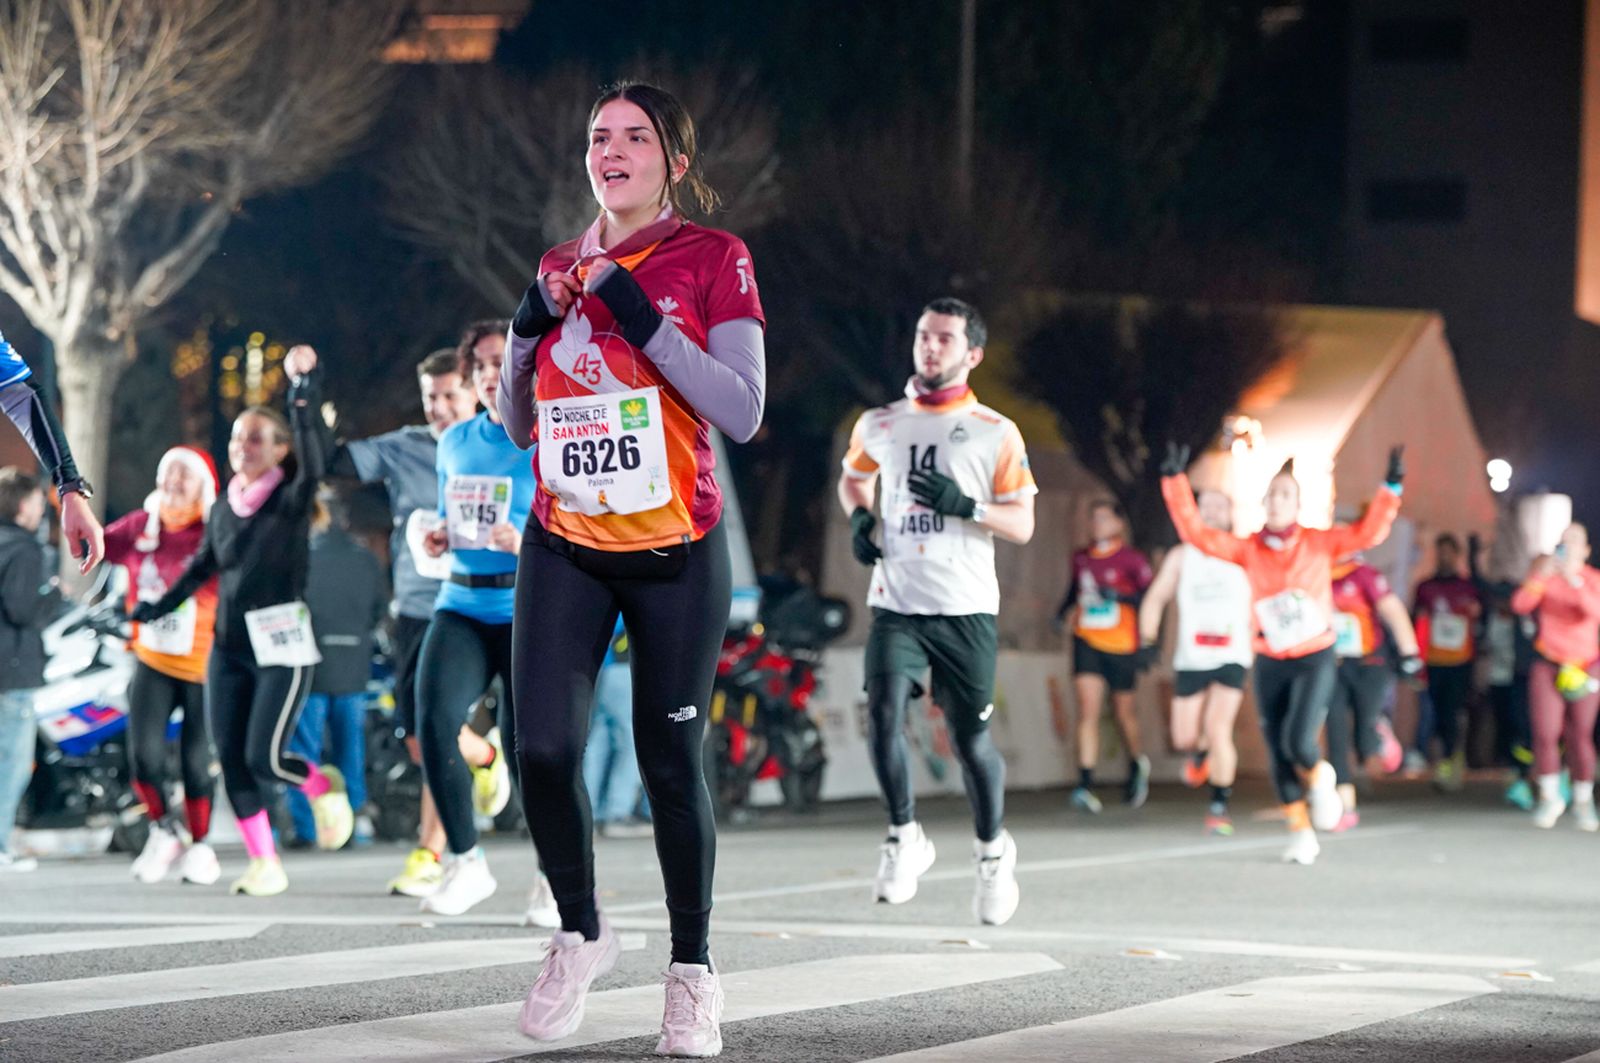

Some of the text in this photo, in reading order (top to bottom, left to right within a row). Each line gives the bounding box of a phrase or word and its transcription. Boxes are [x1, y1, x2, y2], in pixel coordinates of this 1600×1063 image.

[572, 352, 602, 386] 43
[564, 407, 608, 423] NOCHE DE
[553, 426, 574, 440] SAN
[562, 435, 641, 477] 6326
[909, 444, 937, 470] 14
[588, 477, 614, 487] Paloma
